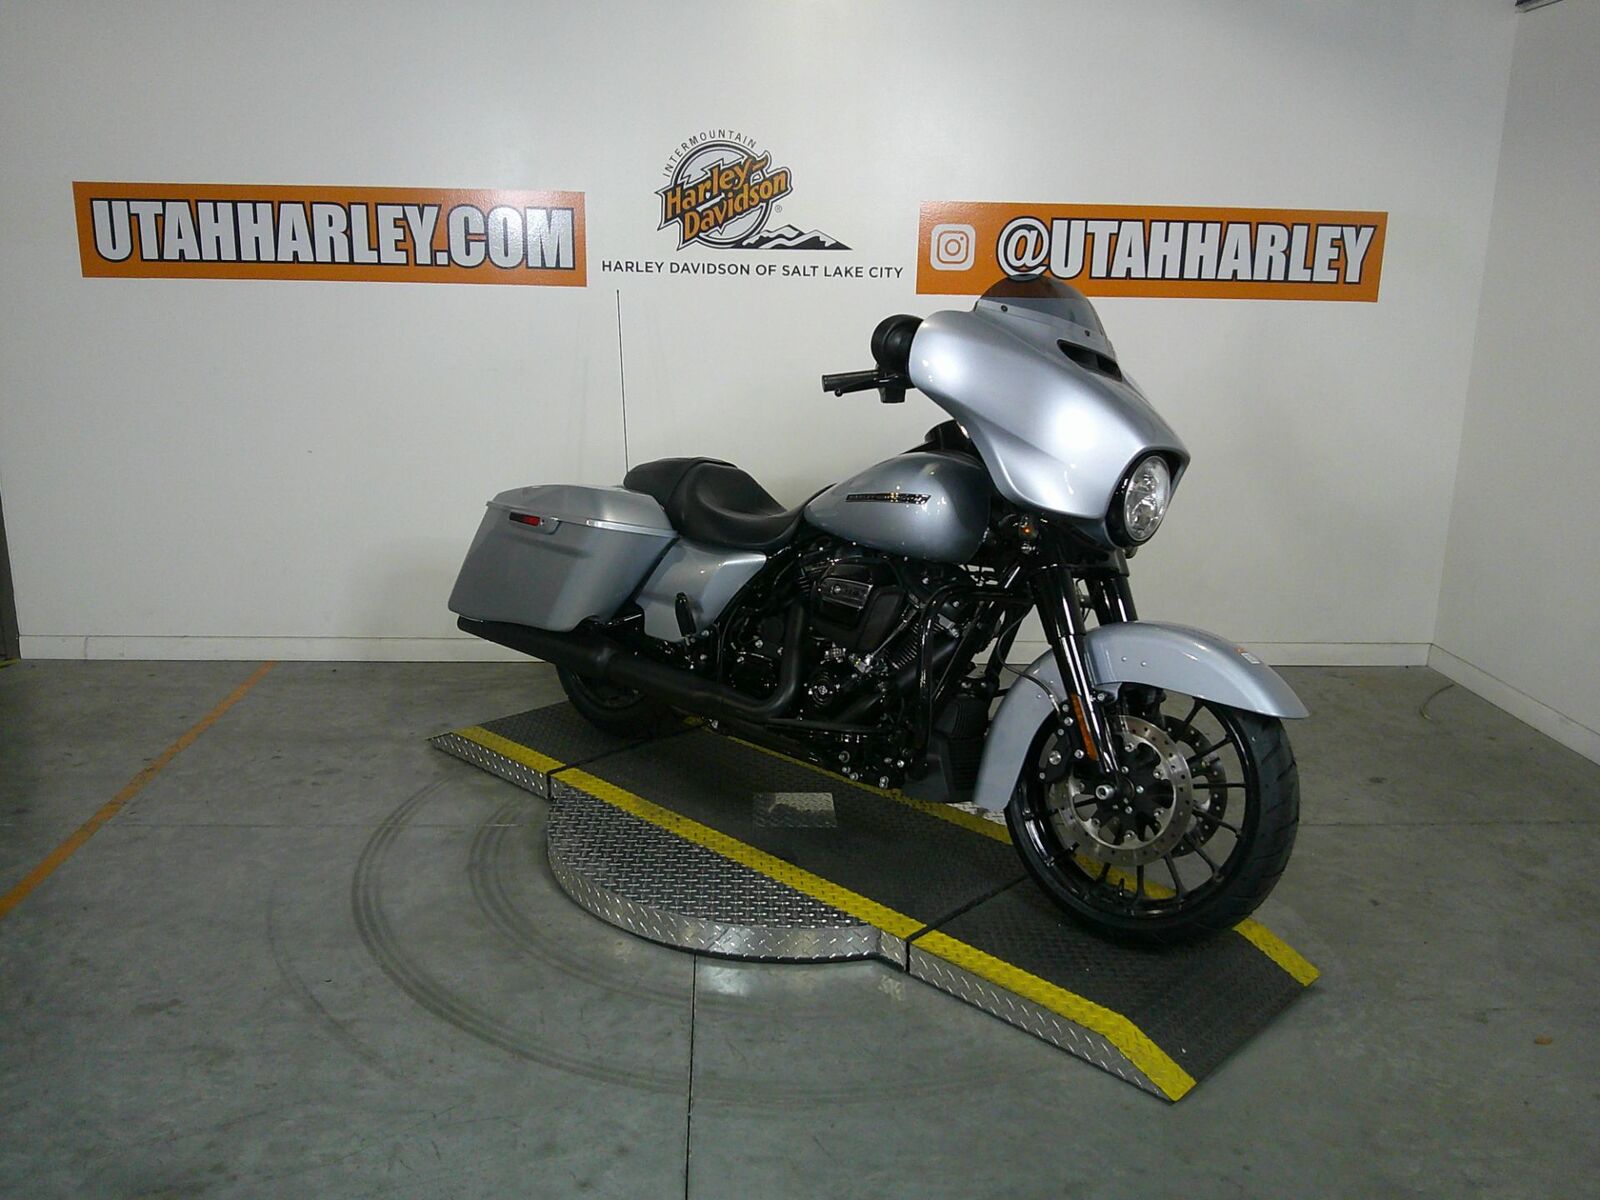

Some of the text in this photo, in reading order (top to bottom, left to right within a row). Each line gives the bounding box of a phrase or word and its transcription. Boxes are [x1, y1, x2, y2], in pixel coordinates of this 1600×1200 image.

[662, 128, 757, 178] INTERMOUNTAIN
[90, 197, 575, 270] UTAHHARLEY.COM
[683, 169, 788, 241] Davidson
[601, 260, 904, 279] HARLEY DAVIDSON OF SALT LAKE CITY
[996, 215, 1377, 284] @UTAHHARLEY
